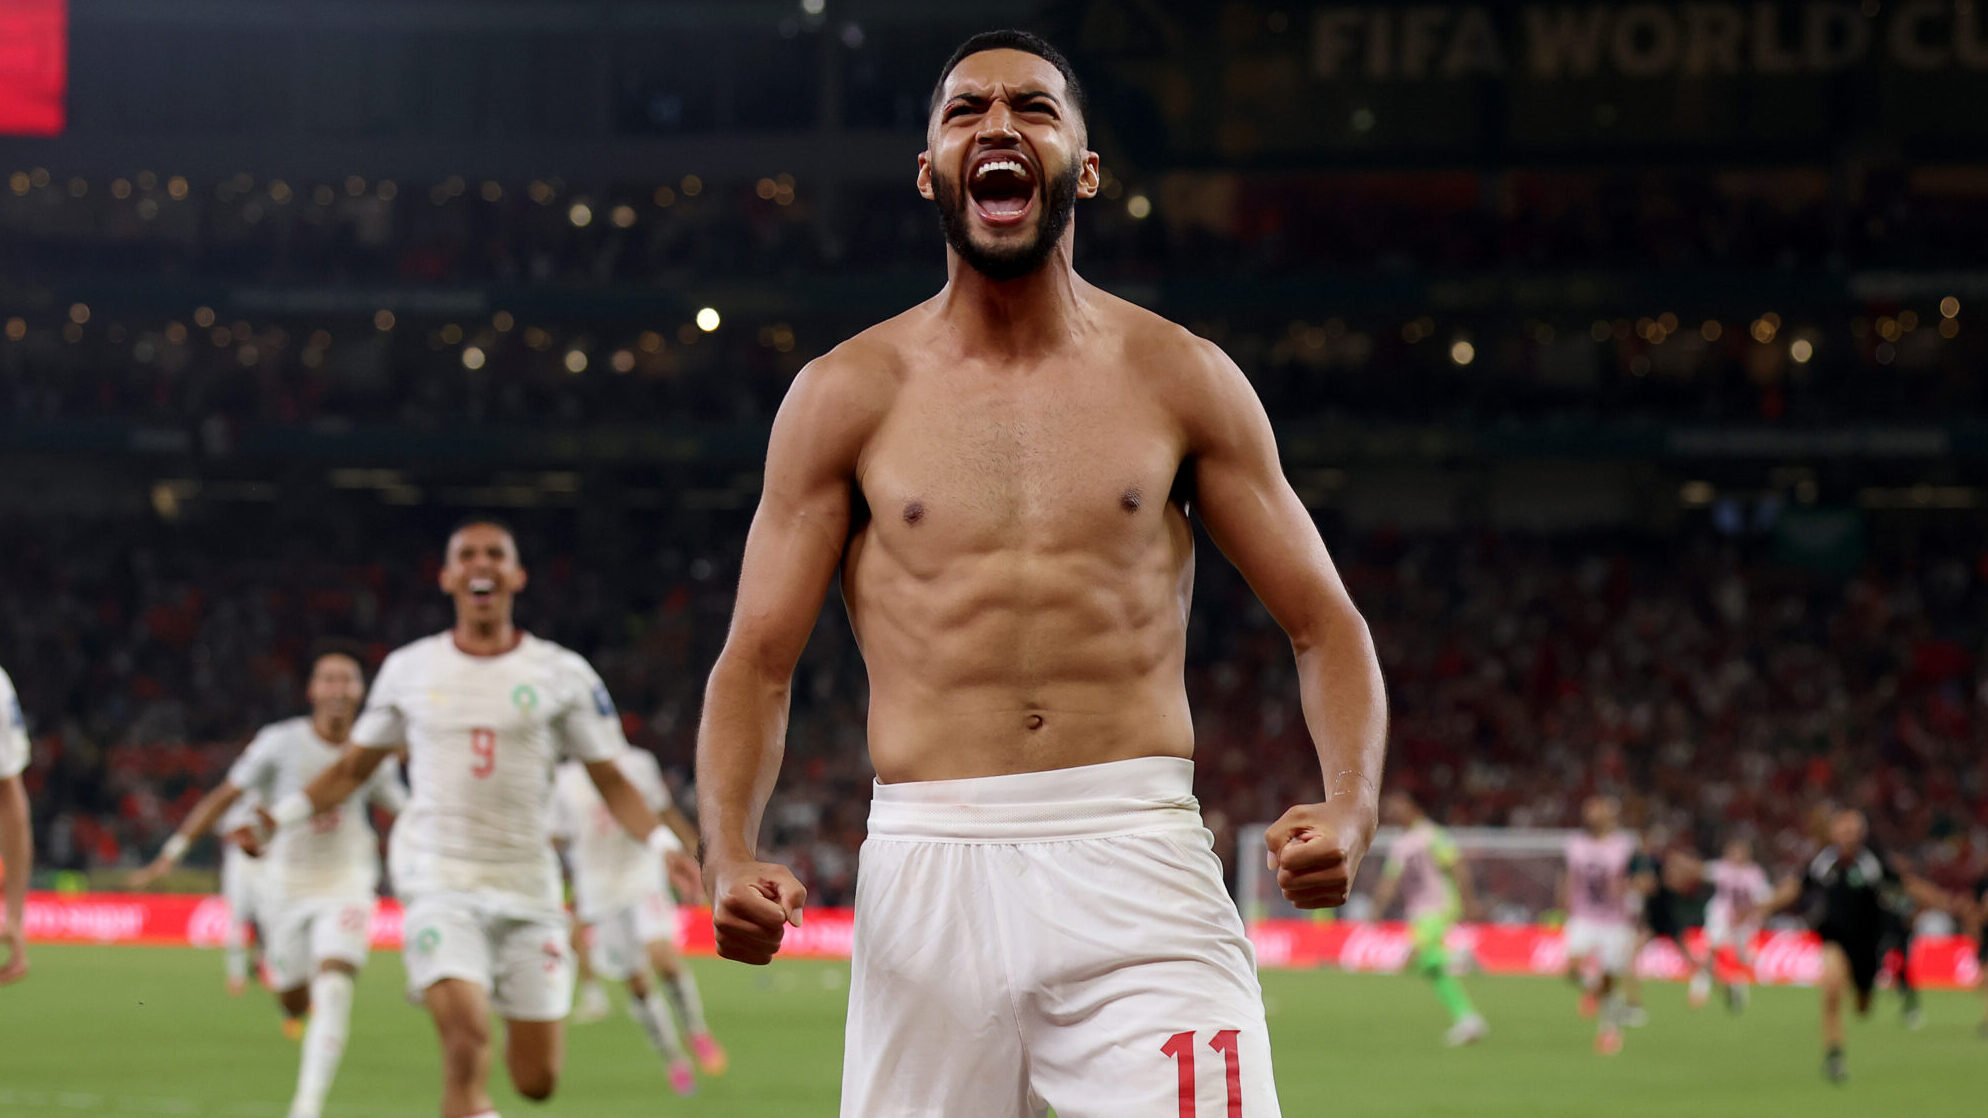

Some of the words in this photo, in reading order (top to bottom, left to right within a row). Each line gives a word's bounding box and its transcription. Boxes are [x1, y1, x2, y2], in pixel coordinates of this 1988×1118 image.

[1313, 6, 1503, 76] FIFA
[1524, 3, 1871, 76] WORLD
[471, 727, 496, 780] 9
[1160, 1030, 1242, 1118] 11
